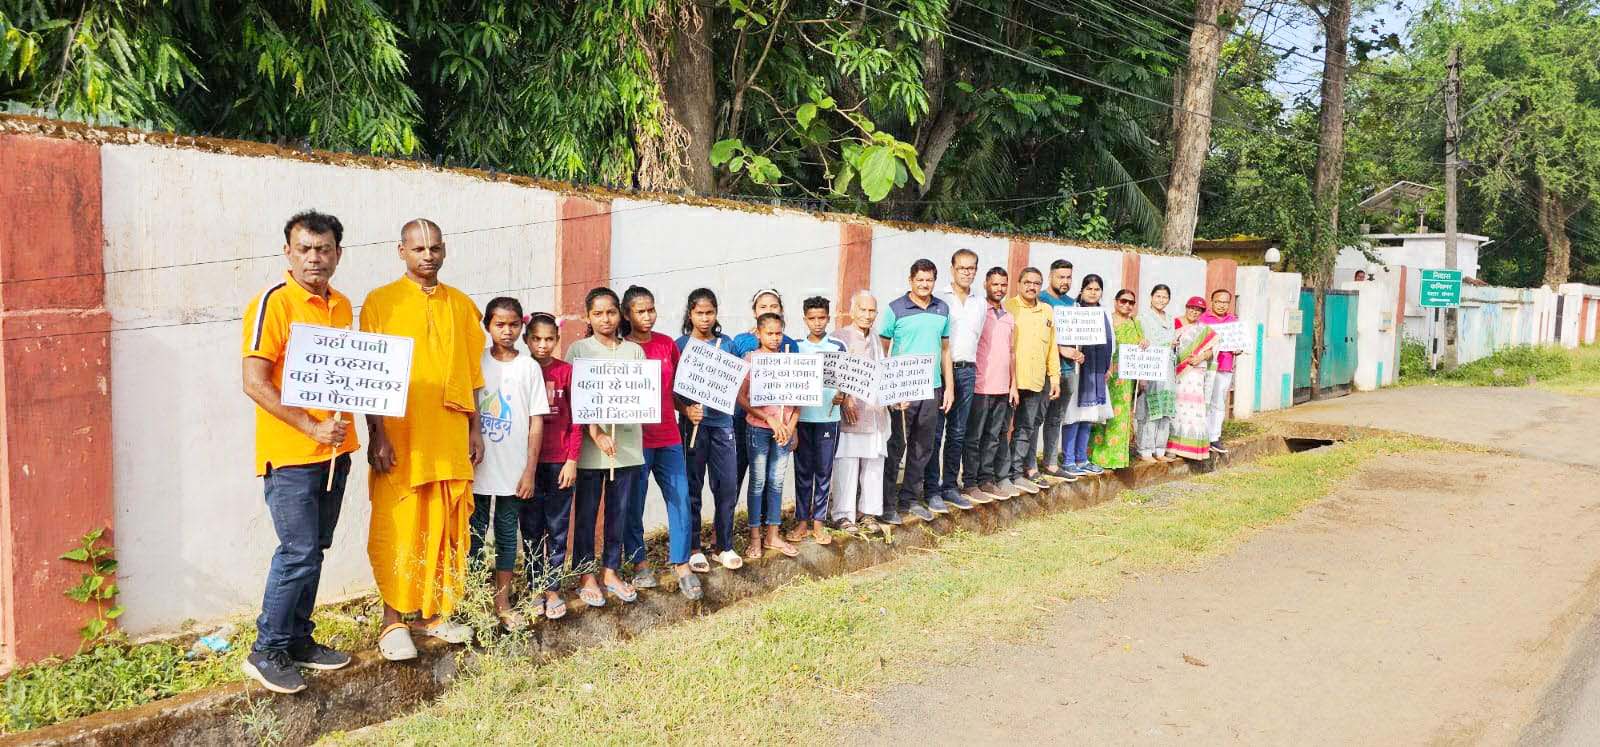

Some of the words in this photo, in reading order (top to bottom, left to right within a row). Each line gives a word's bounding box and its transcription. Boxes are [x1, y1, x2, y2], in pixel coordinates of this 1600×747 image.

[313, 332, 348, 349] जहाँ
[351, 340, 388, 354] पानी
[692, 345, 714, 359] बारिश
[305, 353, 329, 366] का
[334, 358, 389, 374] ठहराव,
[684, 354, 690, 364] है
[705, 365, 716, 375] का
[757, 357, 780, 366] बारिश
[863, 361, 875, 369] का
[590, 362, 629, 375] नालियों
[632, 363, 642, 375] में
[753, 368, 760, 379] है
[289, 369, 318, 383] वहां
[324, 370, 354, 391] डेंगू
[355, 377, 403, 392] मच्छर
[578, 380, 604, 390] बहता
[608, 378, 622, 390] रहे
[625, 378, 655, 391] पानी,
[688, 372, 705, 384] साफ
[707, 380, 728, 394] सफाई
[784, 380, 810, 390] सफाई
[901, 378, 930, 387] आसपास
[839, 382, 864, 394] हमारा
[899, 389, 919, 397] सफाई
[298, 390, 322, 402] का
[328, 390, 377, 407] फैलाव
[592, 392, 603, 404] तो
[608, 395, 640, 404] स्वस्थ
[712, 396, 731, 409] बचाव
[577, 406, 603, 419] रहेगी
[607, 406, 656, 419] जिंदगानी
